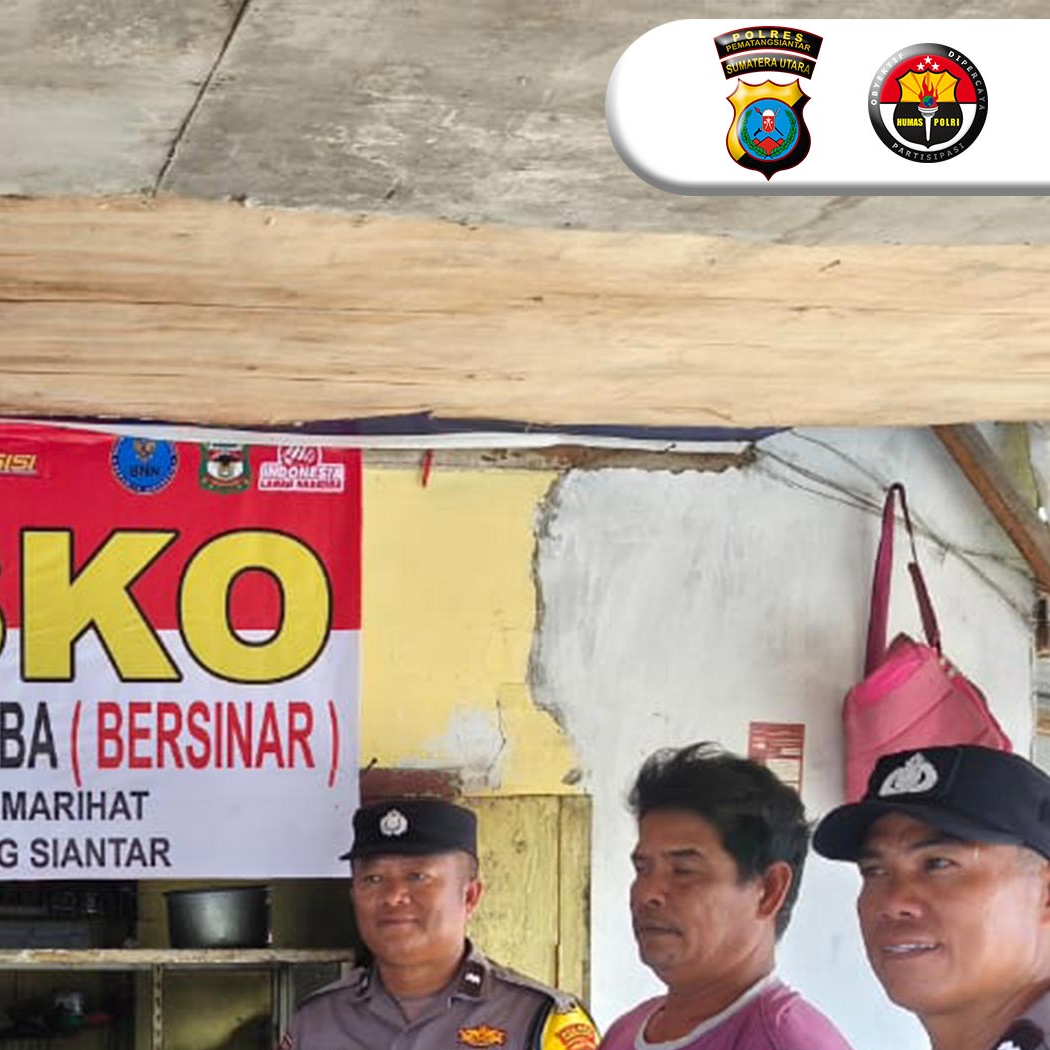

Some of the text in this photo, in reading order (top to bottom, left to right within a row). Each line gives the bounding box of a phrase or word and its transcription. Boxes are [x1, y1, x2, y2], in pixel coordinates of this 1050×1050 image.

[97, 701, 314, 770] BERSINAR
[3, 791, 150, 821] MARIHAT
[31, 838, 171, 869] SIANTAR
